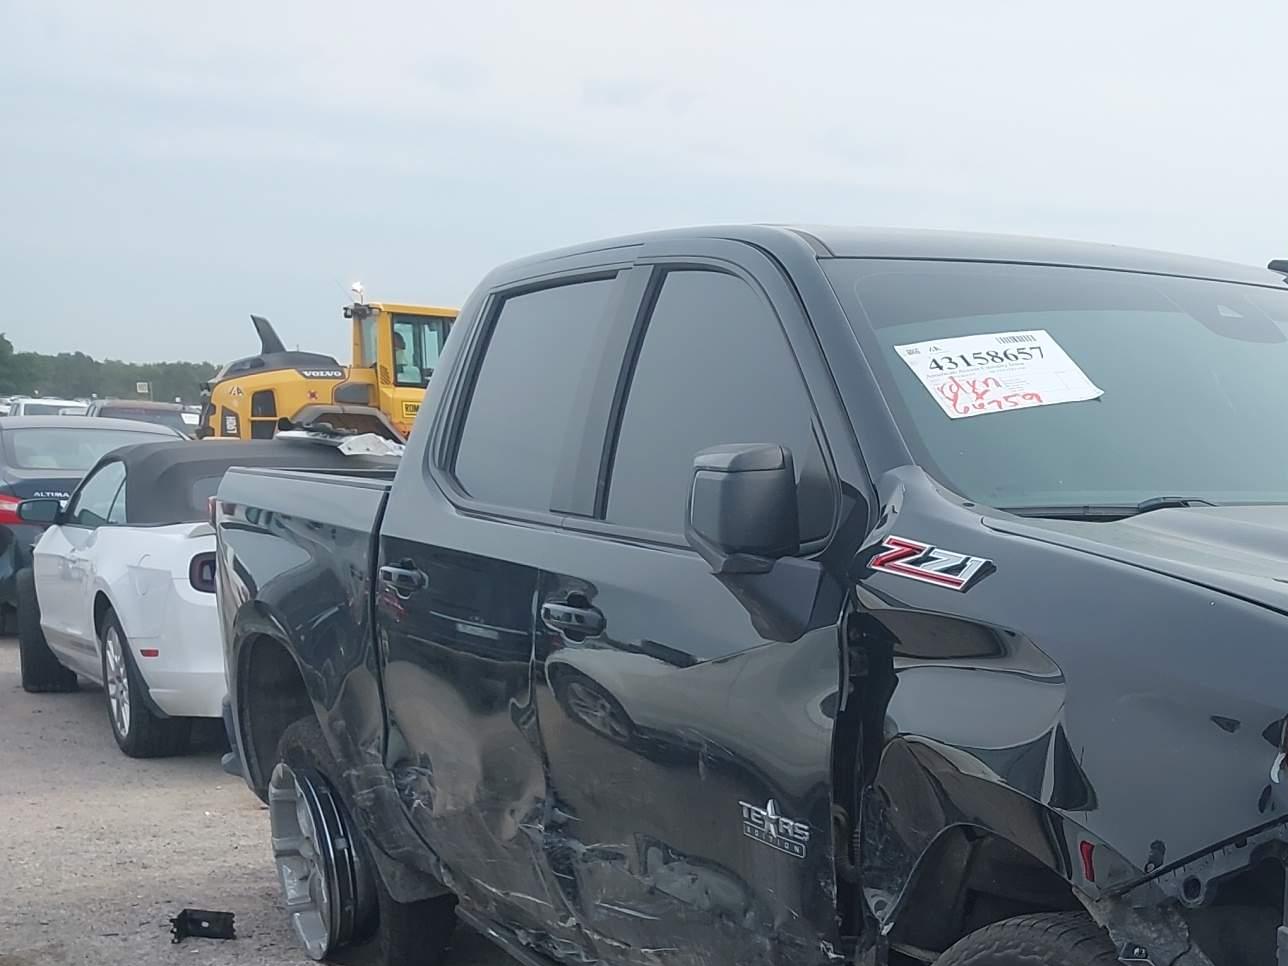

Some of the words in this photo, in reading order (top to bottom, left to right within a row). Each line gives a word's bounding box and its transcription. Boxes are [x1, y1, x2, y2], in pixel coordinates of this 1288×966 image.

[929, 345, 1044, 371] 43158657
[866, 535, 993, 590] Z71
[738, 798, 811, 841] TEXAS
[745, 825, 802, 854] EDITION
